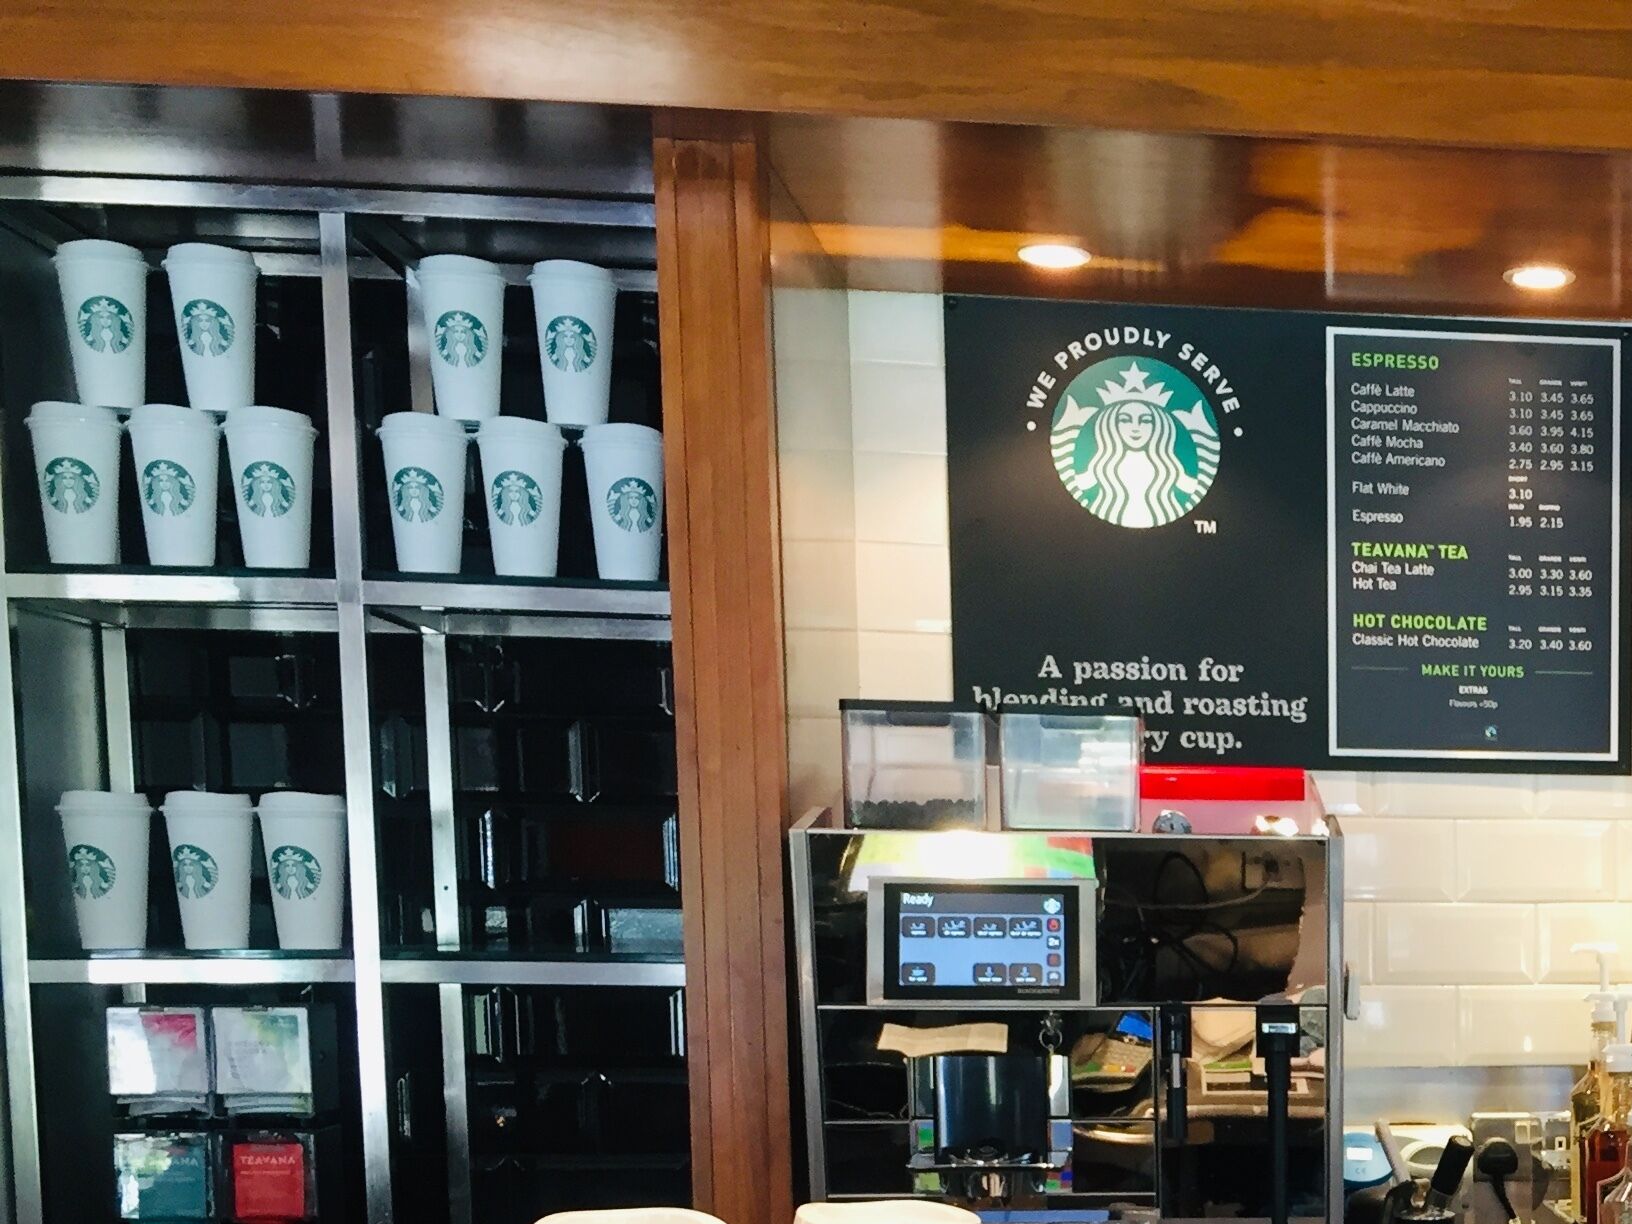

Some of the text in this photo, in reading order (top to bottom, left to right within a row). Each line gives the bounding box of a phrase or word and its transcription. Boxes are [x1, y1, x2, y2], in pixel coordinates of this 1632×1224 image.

[1026, 326, 1240, 414] WE PROUDLY SERVE
[1352, 353, 1438, 370] ESPRESSO
[1386, 385, 1415, 397] Latte
[1509, 391, 1532, 402] 3.10
[1541, 392, 1564, 403] 3.45
[1571, 393, 1593, 404] 3.65
[1351, 400, 1593, 421] Cappuccino 3.10 3.45 3.65
[1351, 417, 1593, 438] Caramel Macchiato 3.60 3.95 4.15
[1386, 436, 1423, 448] Mocha
[1509, 442, 1532, 452] 3.40
[1541, 443, 1564, 454] 3.60
[1571, 444, 1593, 454] 3.80
[1386, 453, 1445, 467] Americano
[1509, 459, 1532, 470] 2.75
[1540, 460, 1563, 470] 2.95
[1570, 461, 1593, 472] 3.15
[1352, 481, 1532, 499] Flat White 3.10
[1194, 520, 1216, 533] TM
[1353, 509, 1563, 528] Espresso 1.95 2.15
[1438, 545, 1468, 559] TEA
[1352, 561, 1592, 580] Chai Tea Latte 3.00 3.30 3.60
[1353, 577, 1592, 597] Hot Tea 2.95 3.15 3.35
[1353, 614, 1487, 630] HOT CHOCOLATE
[1352, 633, 1592, 650] Classic Hot Chocolate 3.20 3.40 3.60
[1038, 655, 1244, 684] A passion for
[1422, 664, 1524, 678] MAKE IT YOURS
[1459, 686, 1488, 694] EXTRAS
[1184, 692, 1308, 723] roasting
[1180, 731, 1242, 754] cup.
[903, 893, 933, 907] Ready
[240, 1155, 295, 1165] TEAVANA
